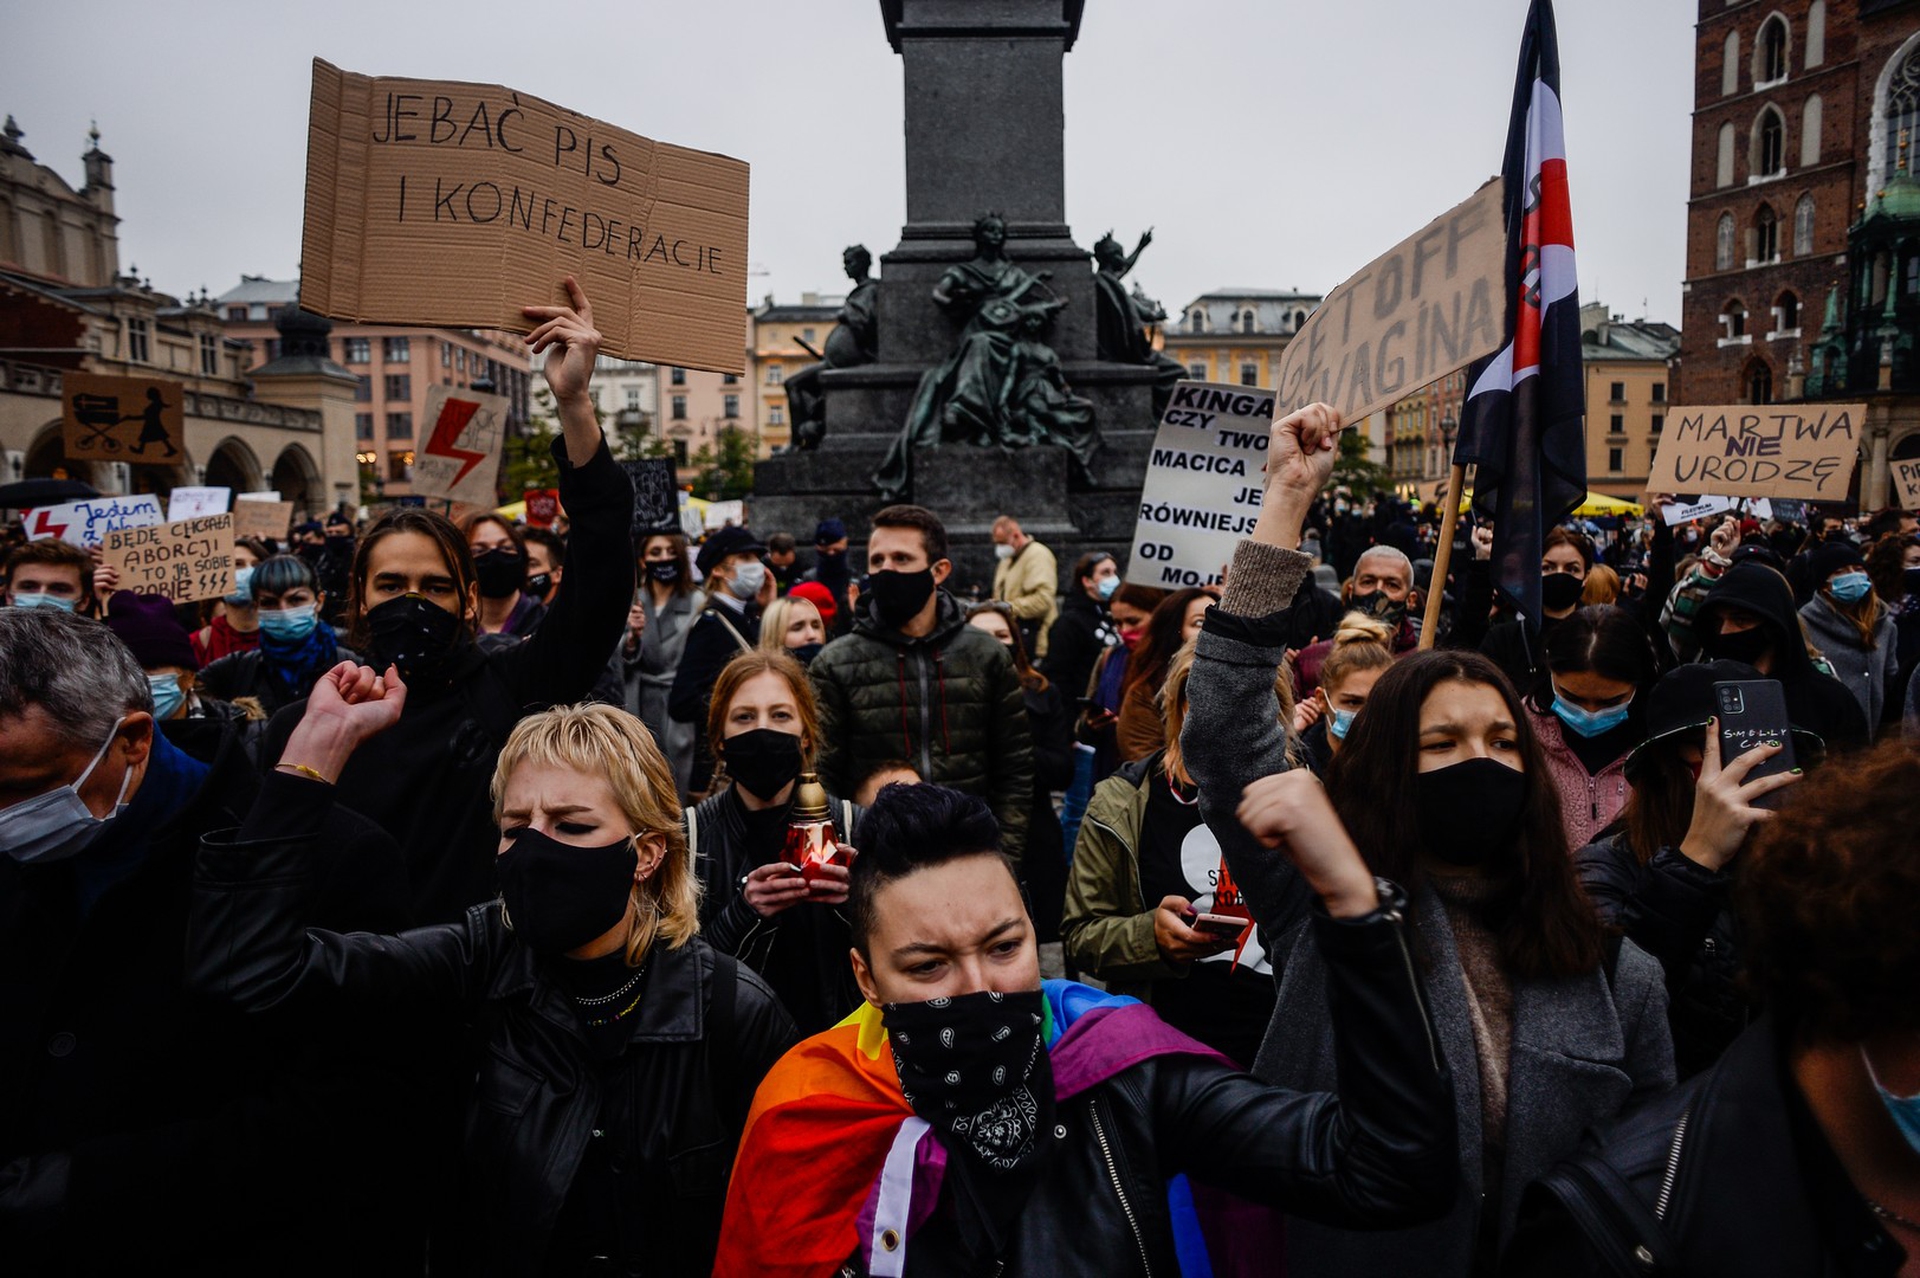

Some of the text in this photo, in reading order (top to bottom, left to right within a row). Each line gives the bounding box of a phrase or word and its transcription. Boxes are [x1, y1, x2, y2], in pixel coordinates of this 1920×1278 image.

[373, 93, 621, 185] JEBAĆ PIS
[399, 175, 406, 222] I
[1373, 198, 1487, 320] OFF
[1173, 386, 1275, 420] KINGA
[1164, 409, 1216, 428] CZY
[1677, 411, 1853, 442] MARTWA
[1219, 430, 1270, 450] TWO
[1724, 436, 1782, 457] NIE
[1152, 449, 1246, 476] MACICA
[1674, 455, 1842, 492] URODZĘ
[1234, 487, 1265, 507] JE
[1906, 483, 1920, 496] K
[124, 539, 218, 568] ABORCJI
[1139, 542, 1174, 561] OD
[142, 566, 166, 581] TO
[194, 555, 231, 573] SOBIE
